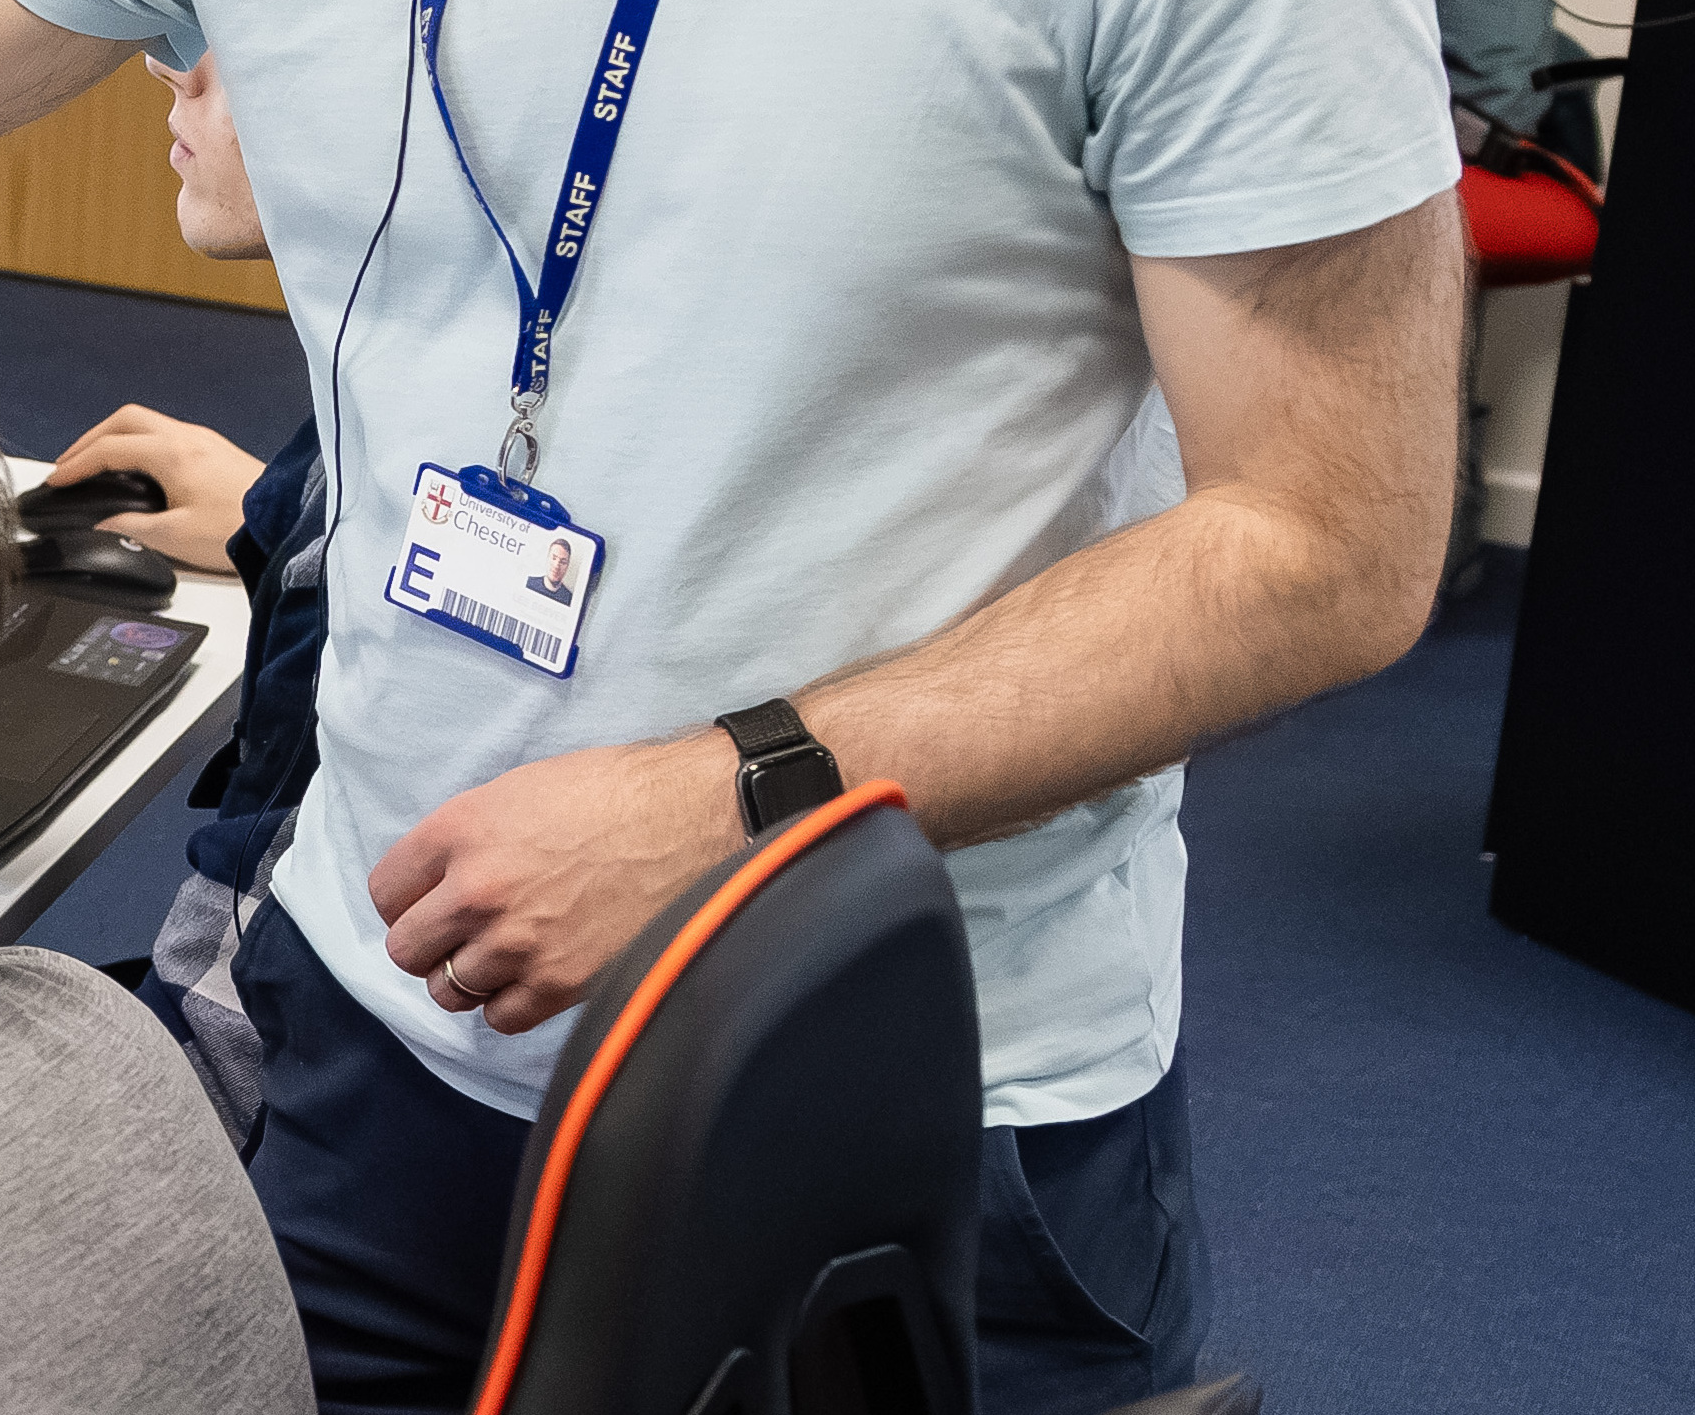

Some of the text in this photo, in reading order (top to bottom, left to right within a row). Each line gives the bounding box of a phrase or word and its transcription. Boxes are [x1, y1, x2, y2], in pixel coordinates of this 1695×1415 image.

[594, 32, 636, 121] STAFF
[555, 171, 596, 259] STAFF
[453, 509, 526, 557] Chester
[458, 492, 531, 535] University of
[399, 542, 441, 602] E
